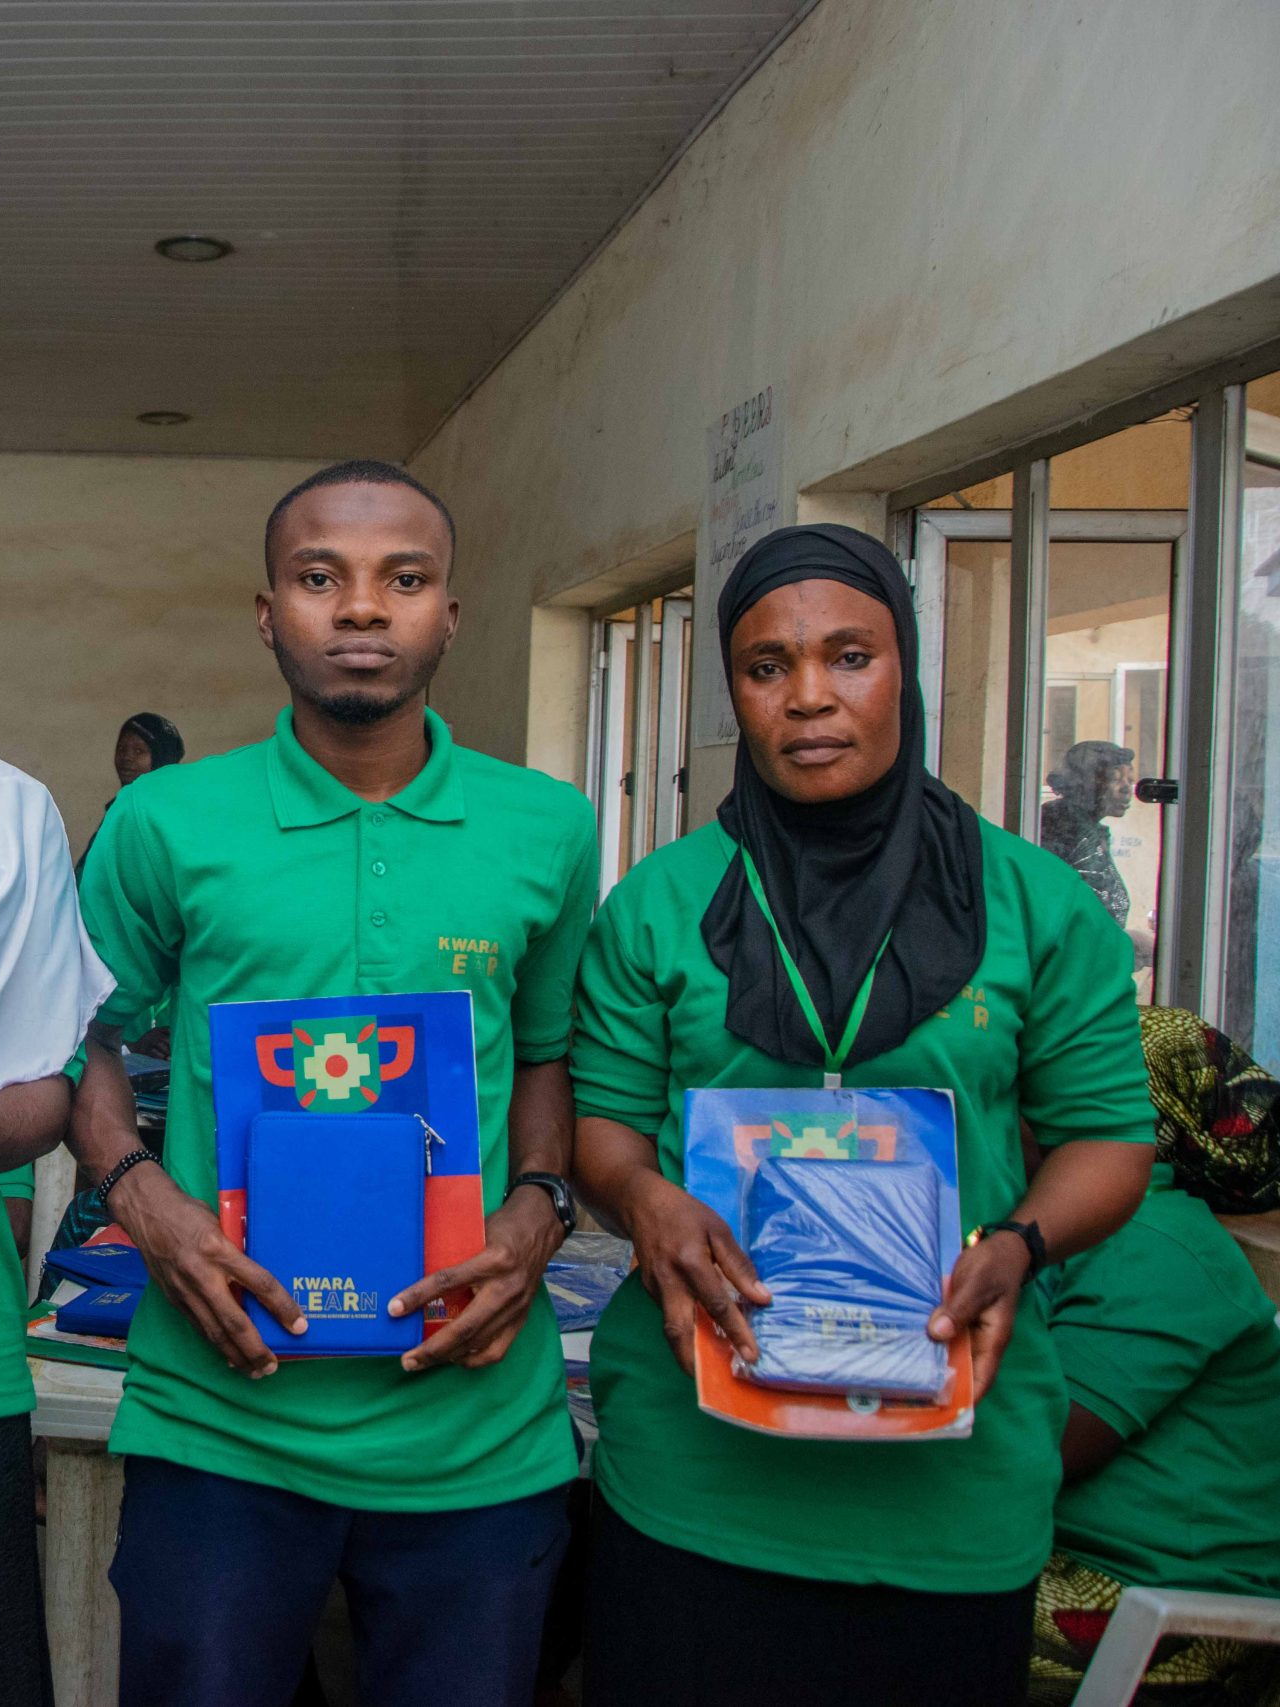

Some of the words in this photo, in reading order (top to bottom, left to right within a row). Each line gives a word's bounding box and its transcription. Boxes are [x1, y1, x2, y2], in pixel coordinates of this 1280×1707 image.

[438, 936, 499, 953] KWARA
[293, 1276, 356, 1290] KWARA
[293, 1290, 378, 1312] LEARN
[804, 1305, 873, 1321] KWARA
